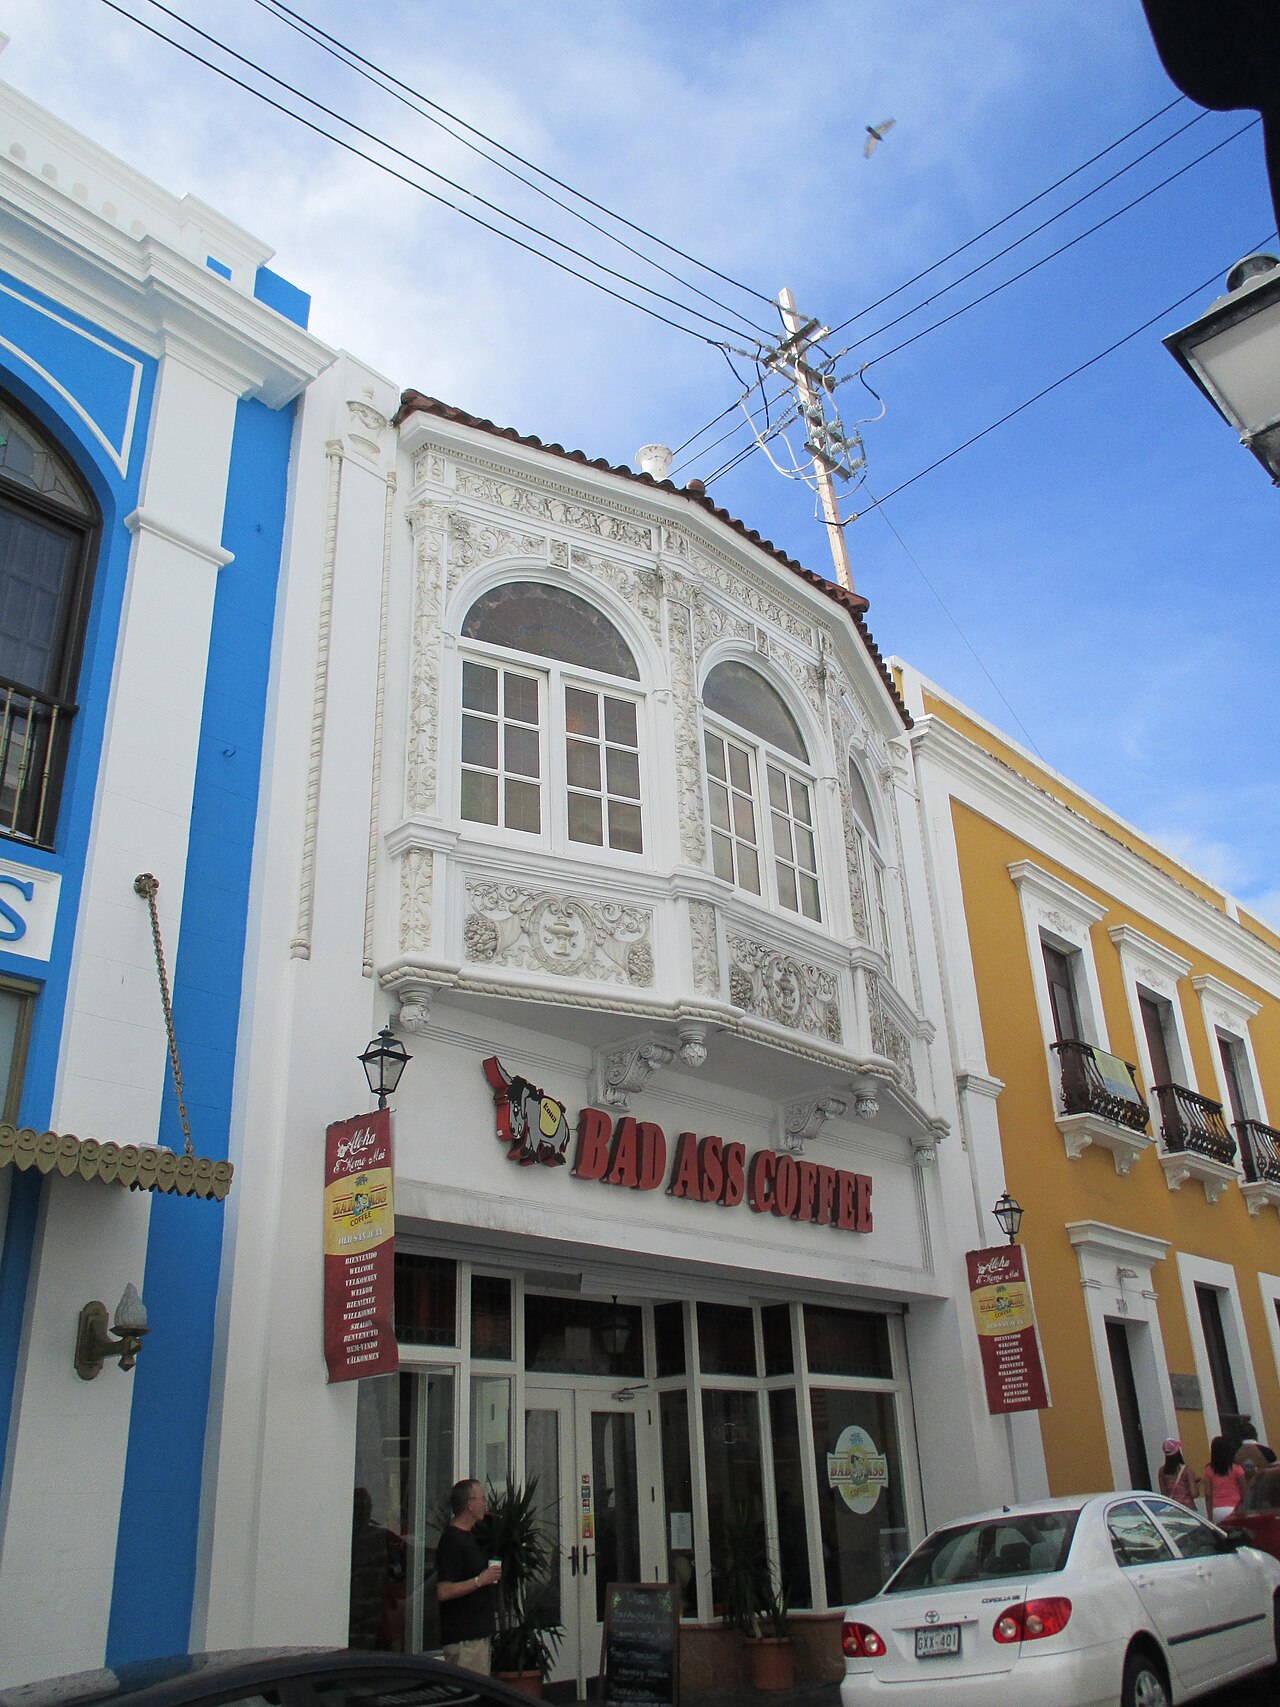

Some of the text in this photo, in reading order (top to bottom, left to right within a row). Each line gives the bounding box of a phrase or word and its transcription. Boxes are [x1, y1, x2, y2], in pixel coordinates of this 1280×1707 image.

[543, 1102, 557, 1123] kona
[338, 1127, 376, 1155] Aloha
[572, 1108, 873, 1233] BAD ASS COFFEE
[350, 1210, 372, 1227] COFFEE
[338, 1234, 353, 1246] OLD
[345, 1251, 378, 1265] BIENVENIDO
[349, 1263, 375, 1275] WELCOME
[345, 1273, 378, 1287] VELKOMMEN
[343, 1329, 379, 1343] BENVENUTO
[830, 1461, 851, 1477] BAD
[918, 1633, 956, 1650] GXX 401
